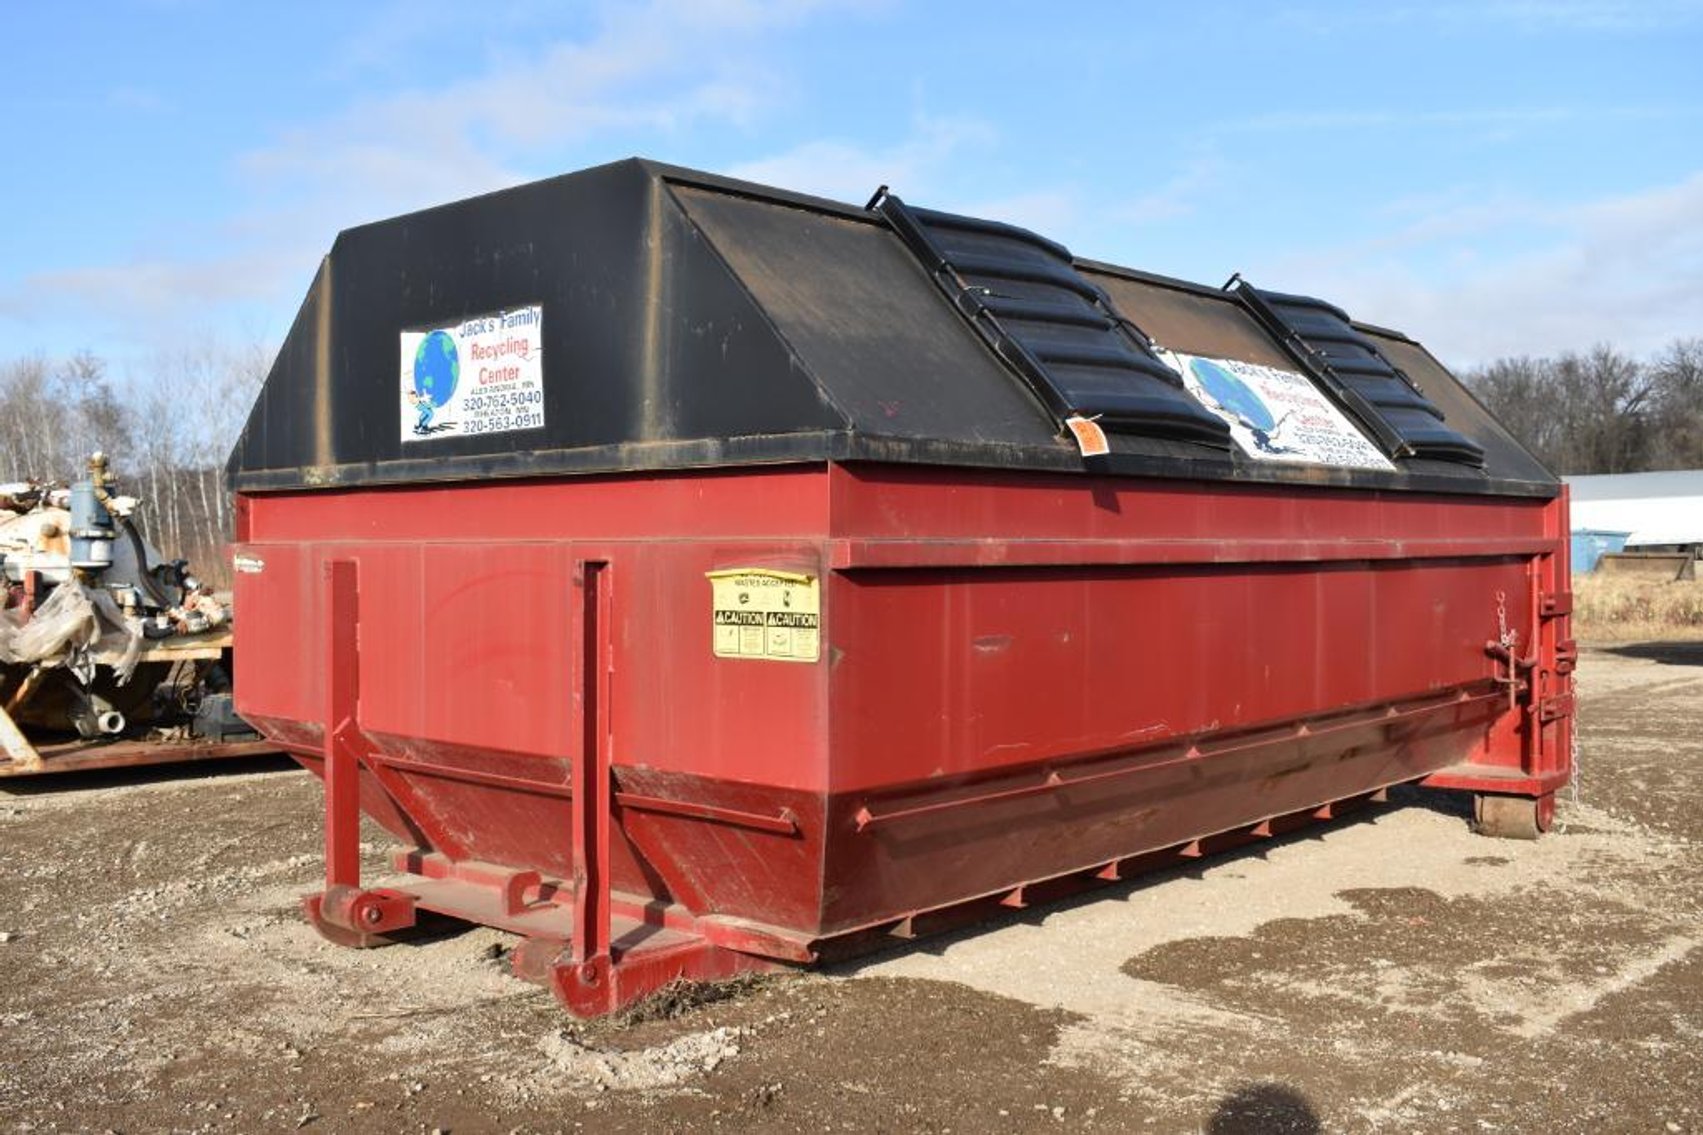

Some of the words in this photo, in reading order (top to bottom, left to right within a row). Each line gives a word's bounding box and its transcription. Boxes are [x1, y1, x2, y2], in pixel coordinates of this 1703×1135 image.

[459, 319, 494, 338] Jack's
[500, 306, 540, 330] Family
[471, 336, 529, 361] Recycling
[479, 366, 519, 385] Center
[463, 413, 541, 433] 320-563-0911
[724, 611, 763, 625] CAUTION
[776, 613, 817, 626] CAUTION
